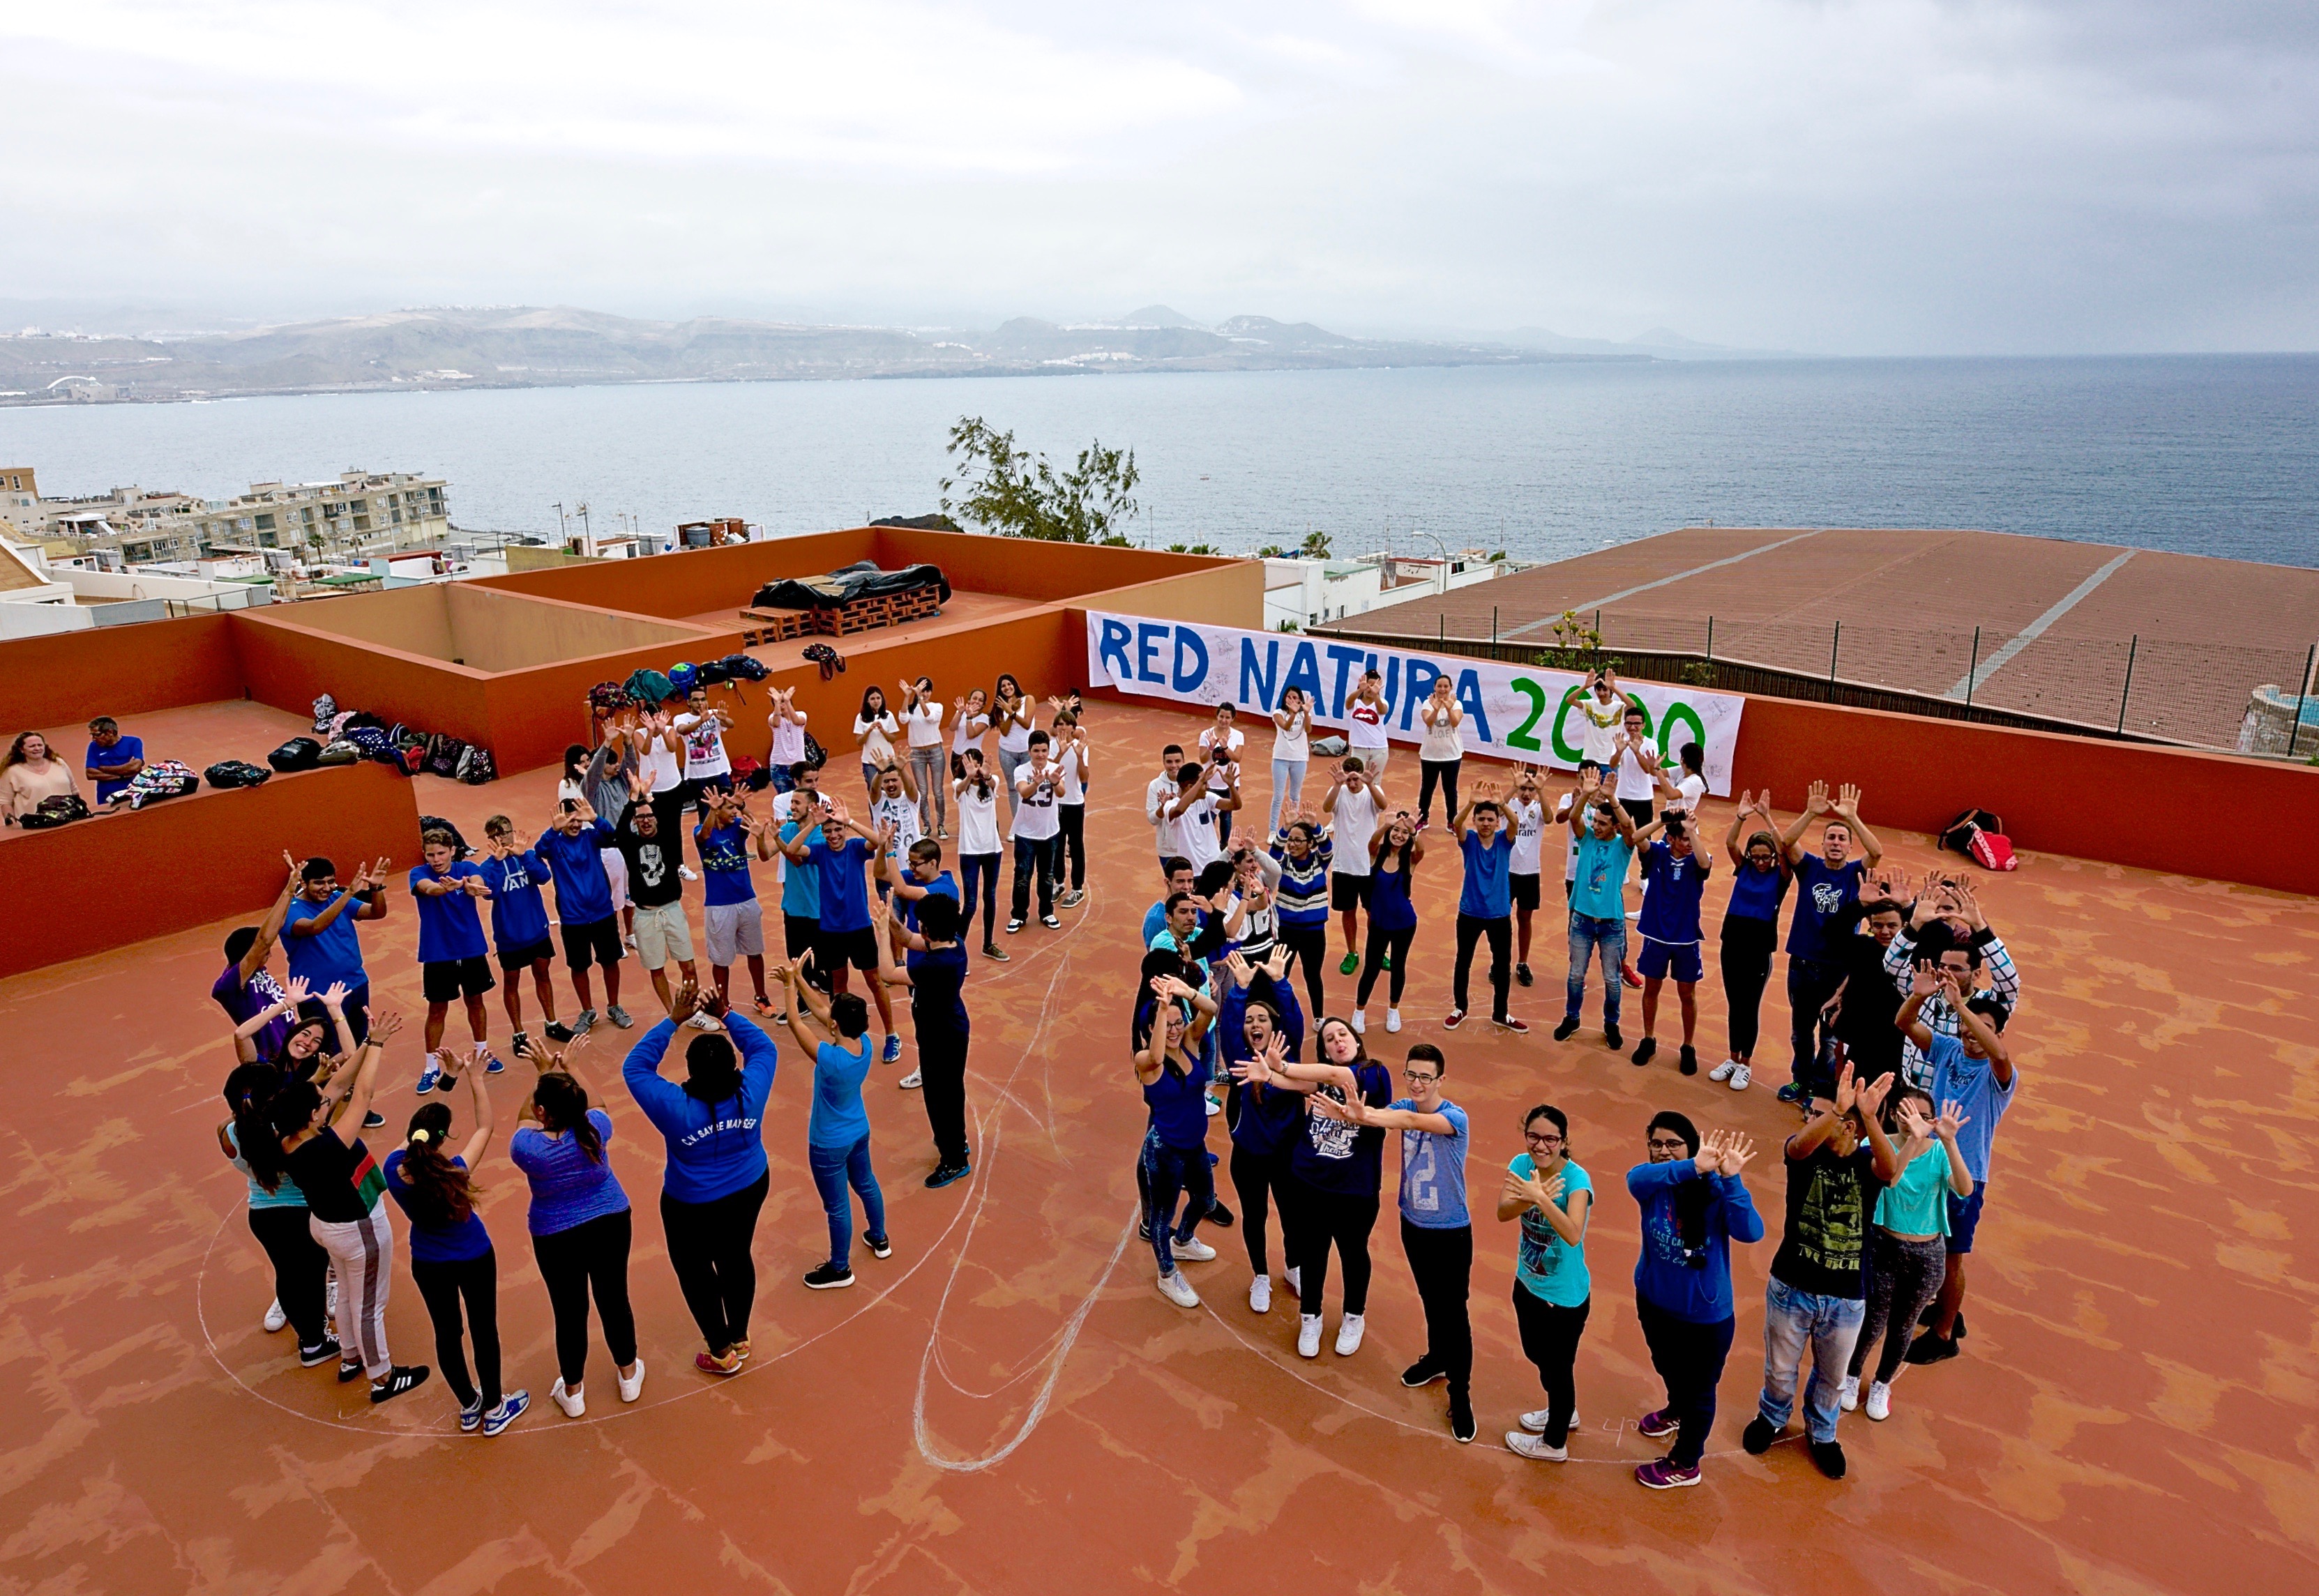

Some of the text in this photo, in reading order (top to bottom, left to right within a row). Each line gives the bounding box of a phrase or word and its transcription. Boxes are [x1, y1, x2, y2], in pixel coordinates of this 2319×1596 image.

[1100, 619, 1209, 692] RED
[1239, 637, 1492, 743] NATURA
[1434, 729, 1450, 738] LOVE
